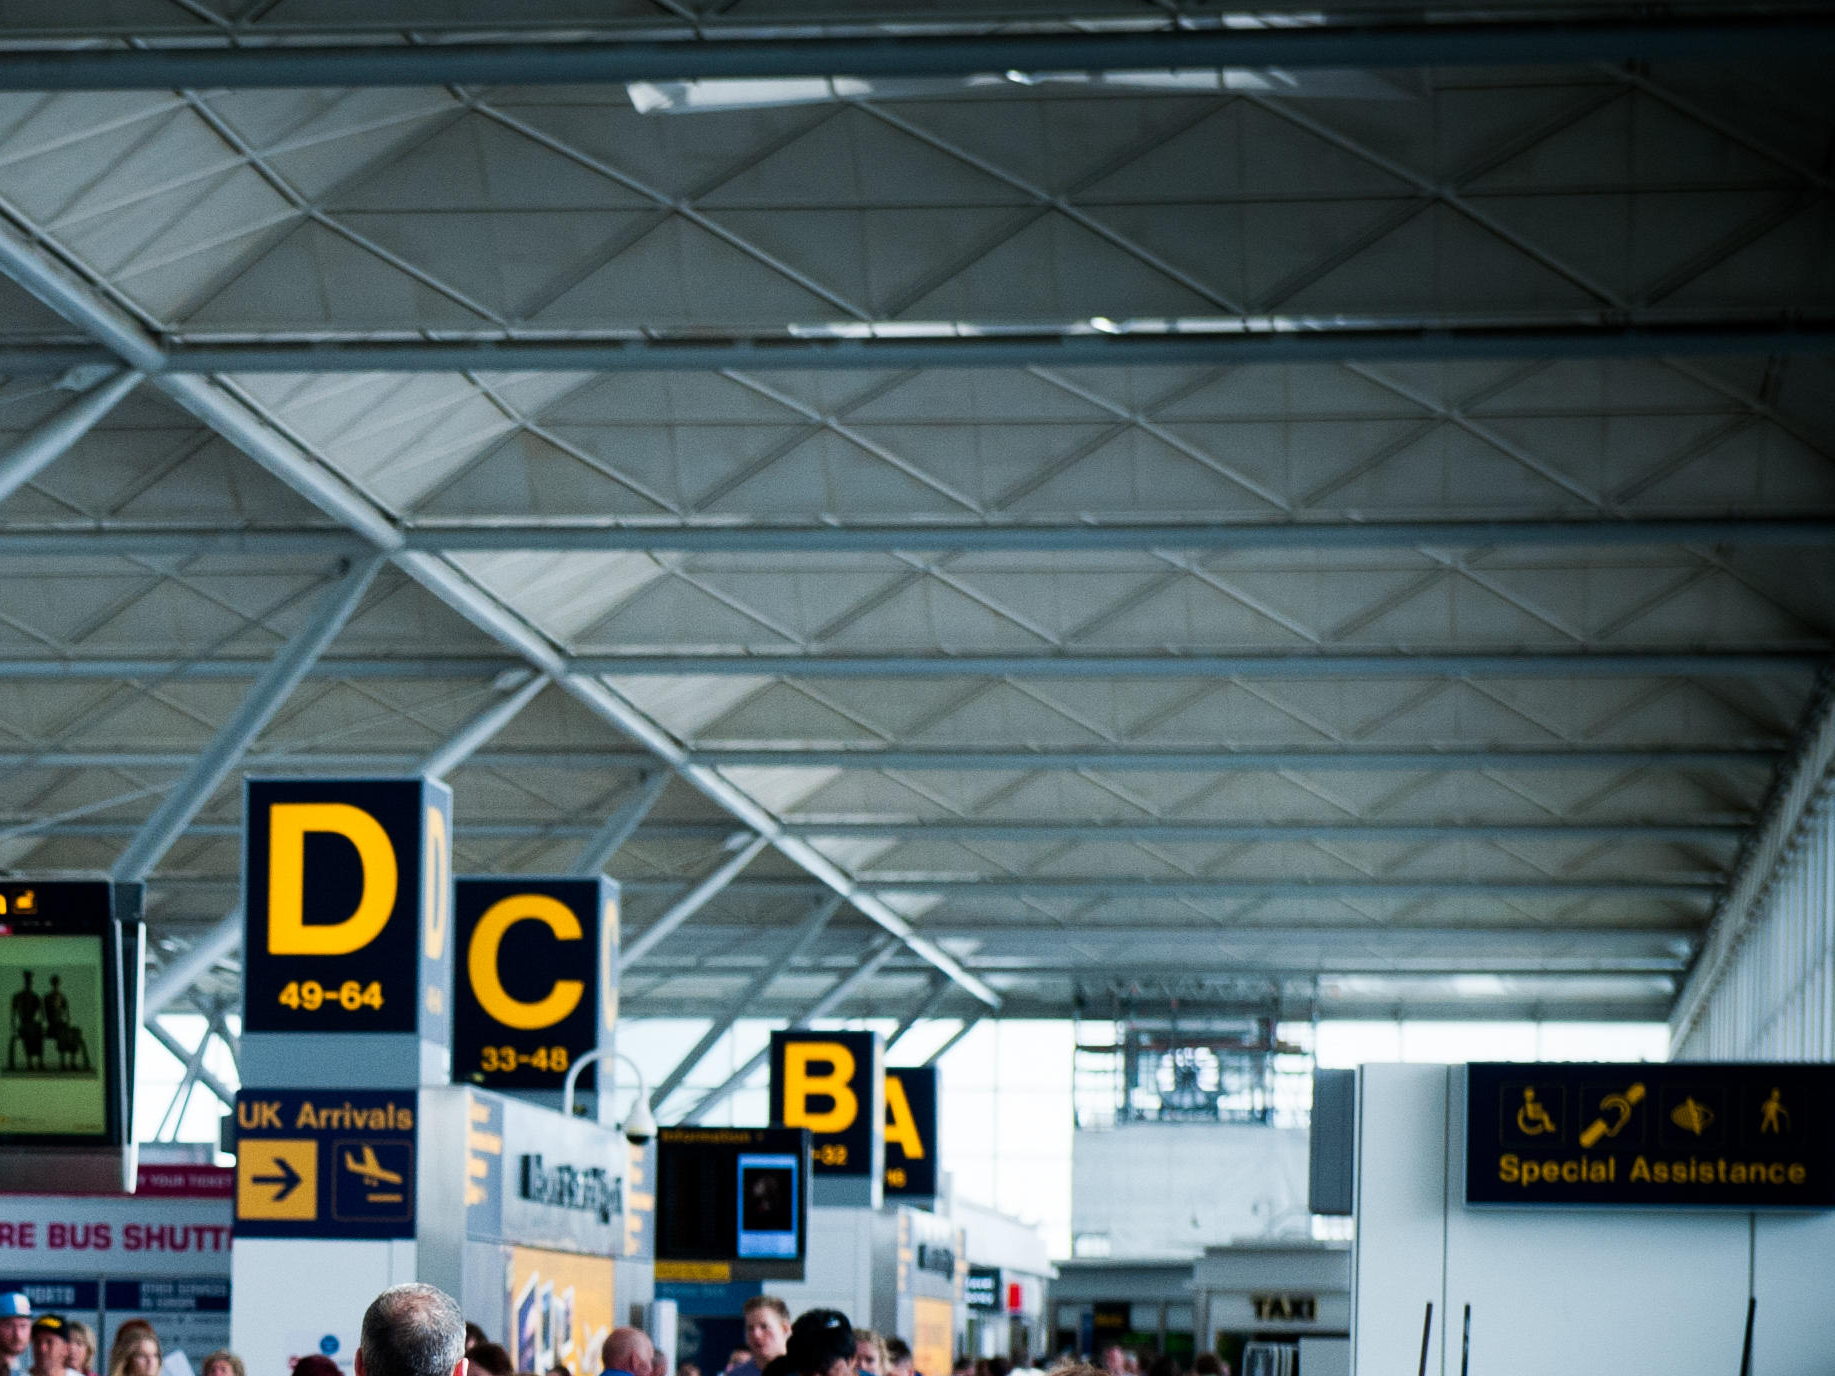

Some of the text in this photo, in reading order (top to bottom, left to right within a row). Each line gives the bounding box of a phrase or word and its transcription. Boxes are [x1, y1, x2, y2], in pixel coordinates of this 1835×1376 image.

[268, 803, 398, 955] D
[424, 806, 448, 960] D
[468, 893, 586, 1031] C
[278, 980, 385, 1012] 49-64
[480, 1046, 569, 1073] 33-48
[783, 1041, 859, 1134] B
[238, 1102, 414, 1131] UK Arrivals
[884, 1076, 925, 1159] A
[1499, 1154, 1807, 1187] Special Assistance
[48, 1223, 112, 1251] BUS
[1251, 1293, 1318, 1321] TAXI
